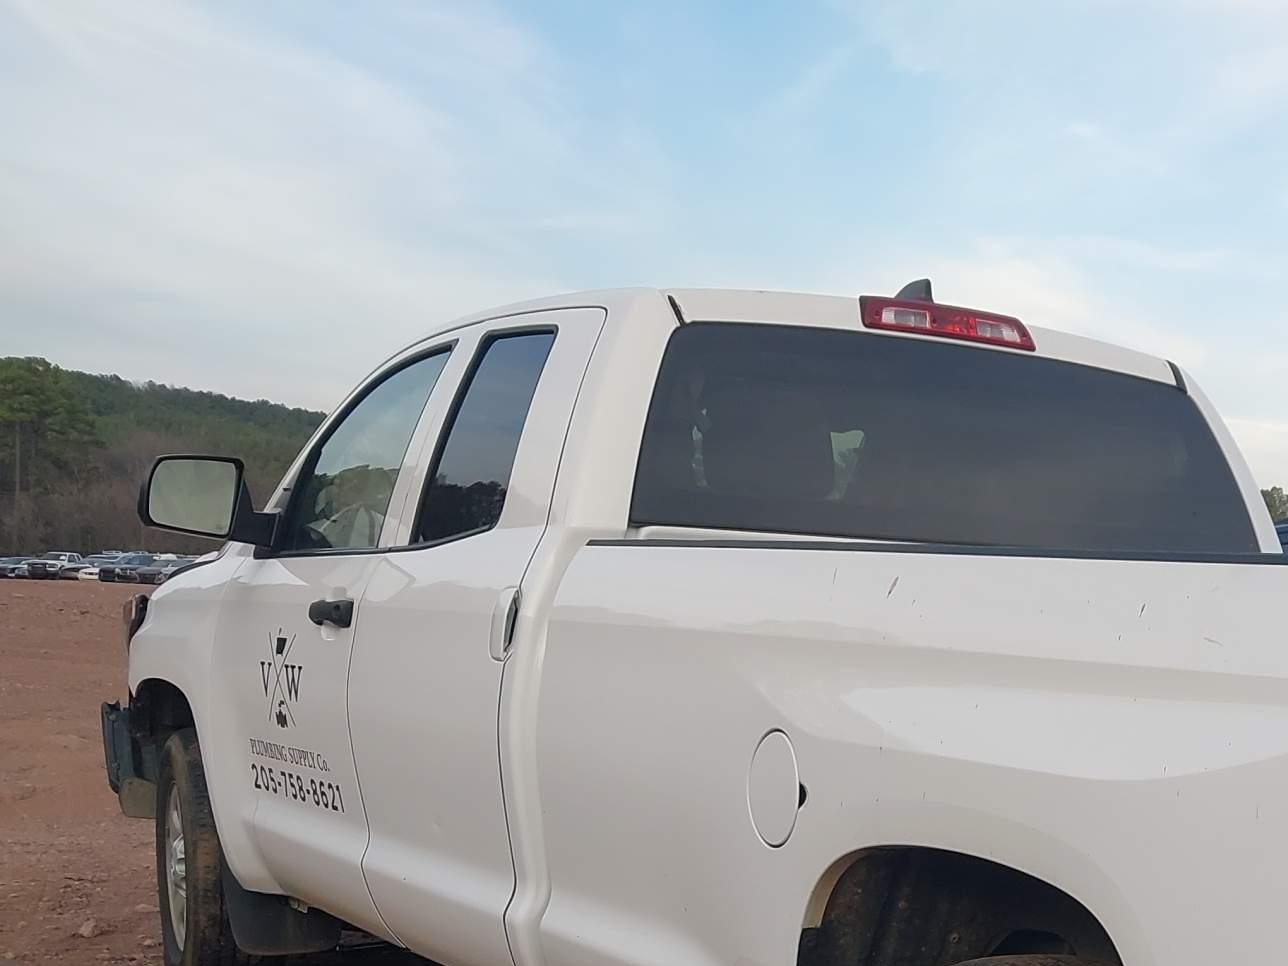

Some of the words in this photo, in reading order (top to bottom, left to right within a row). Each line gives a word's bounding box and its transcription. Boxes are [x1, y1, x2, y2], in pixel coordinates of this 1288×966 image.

[249, 738, 288, 762] PLUMBING
[287, 747, 316, 769] SUPPLY
[251, 763, 345, 814] 205-758-8621
